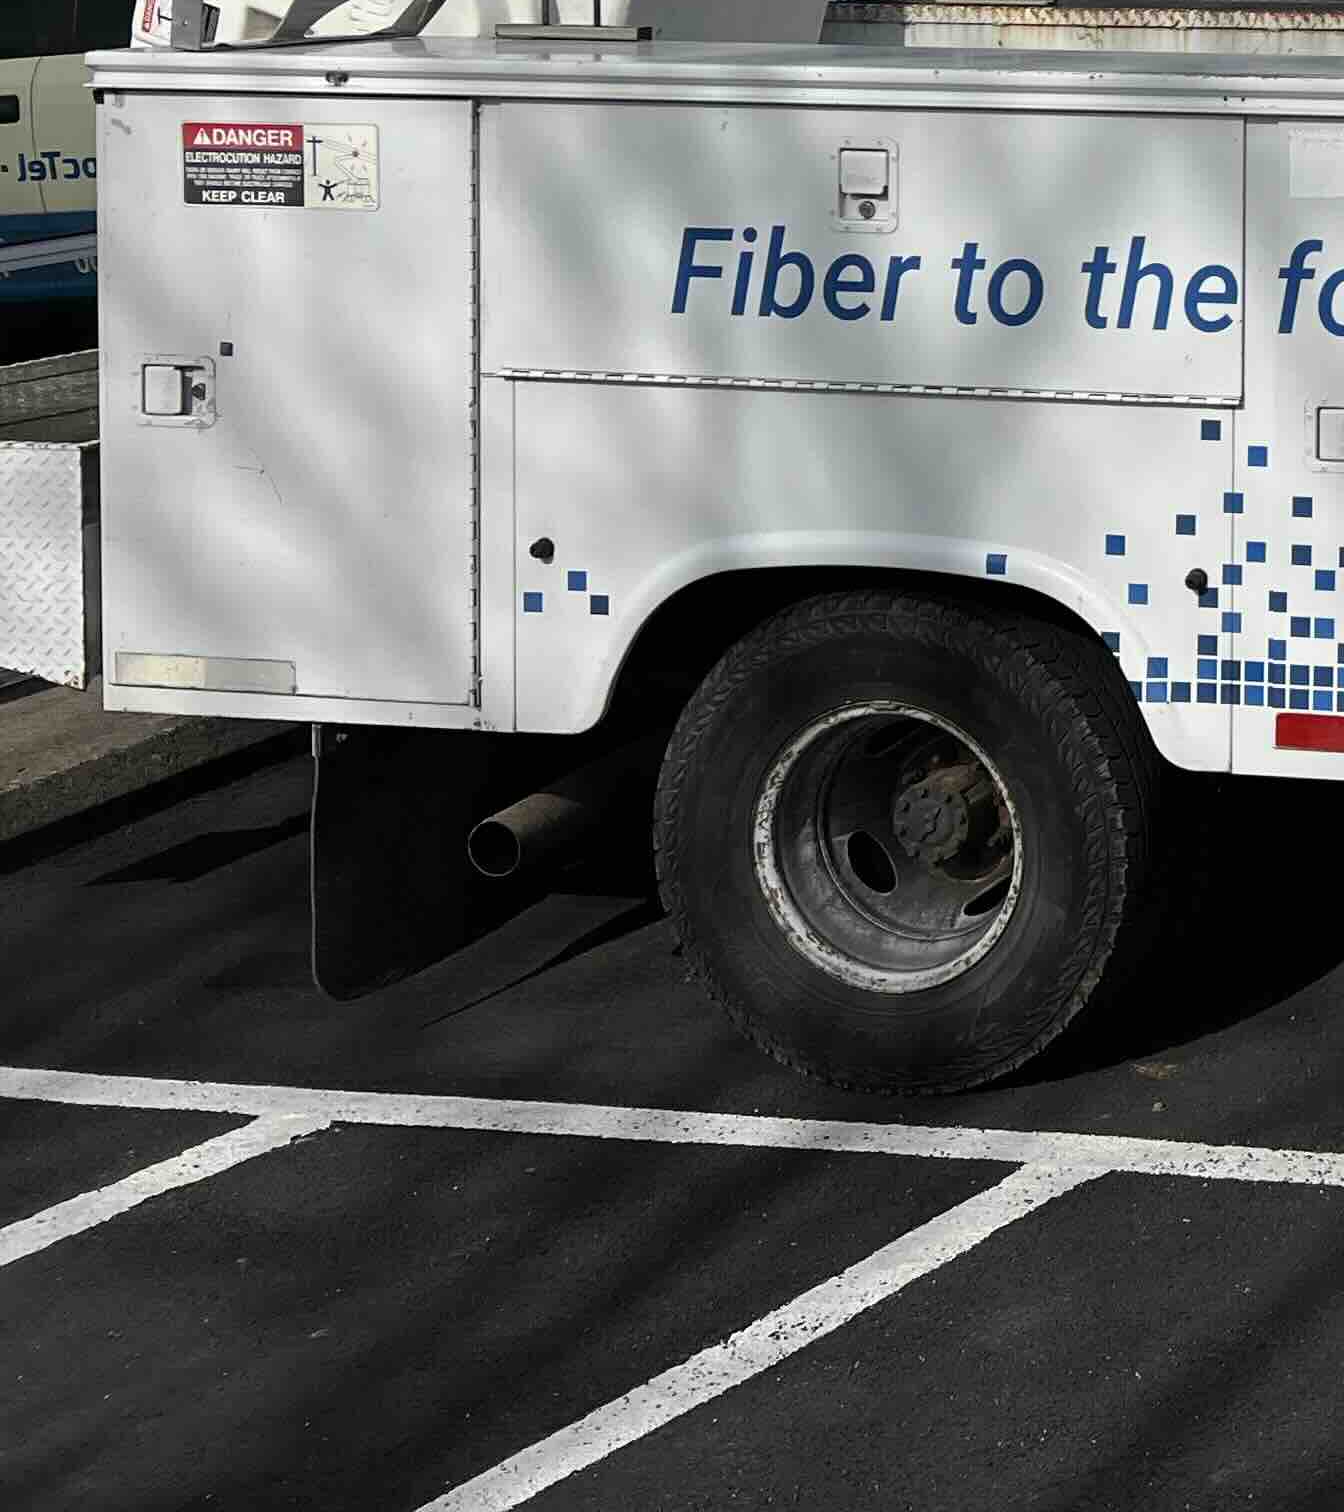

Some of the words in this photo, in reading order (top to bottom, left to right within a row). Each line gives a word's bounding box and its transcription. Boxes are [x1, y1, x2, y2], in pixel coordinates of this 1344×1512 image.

[212, 128, 294, 147] DANGER
[185, 151, 261, 164] ELECTROCUTION
[263, 153, 303, 165] HAZARD
[202, 190, 237, 202] KEEP
[241, 191, 285, 204] CLEAR
[672, 225, 921, 321] Fiber
[951, 242, 1044, 326] to
[1081, 235, 1239, 333] the
